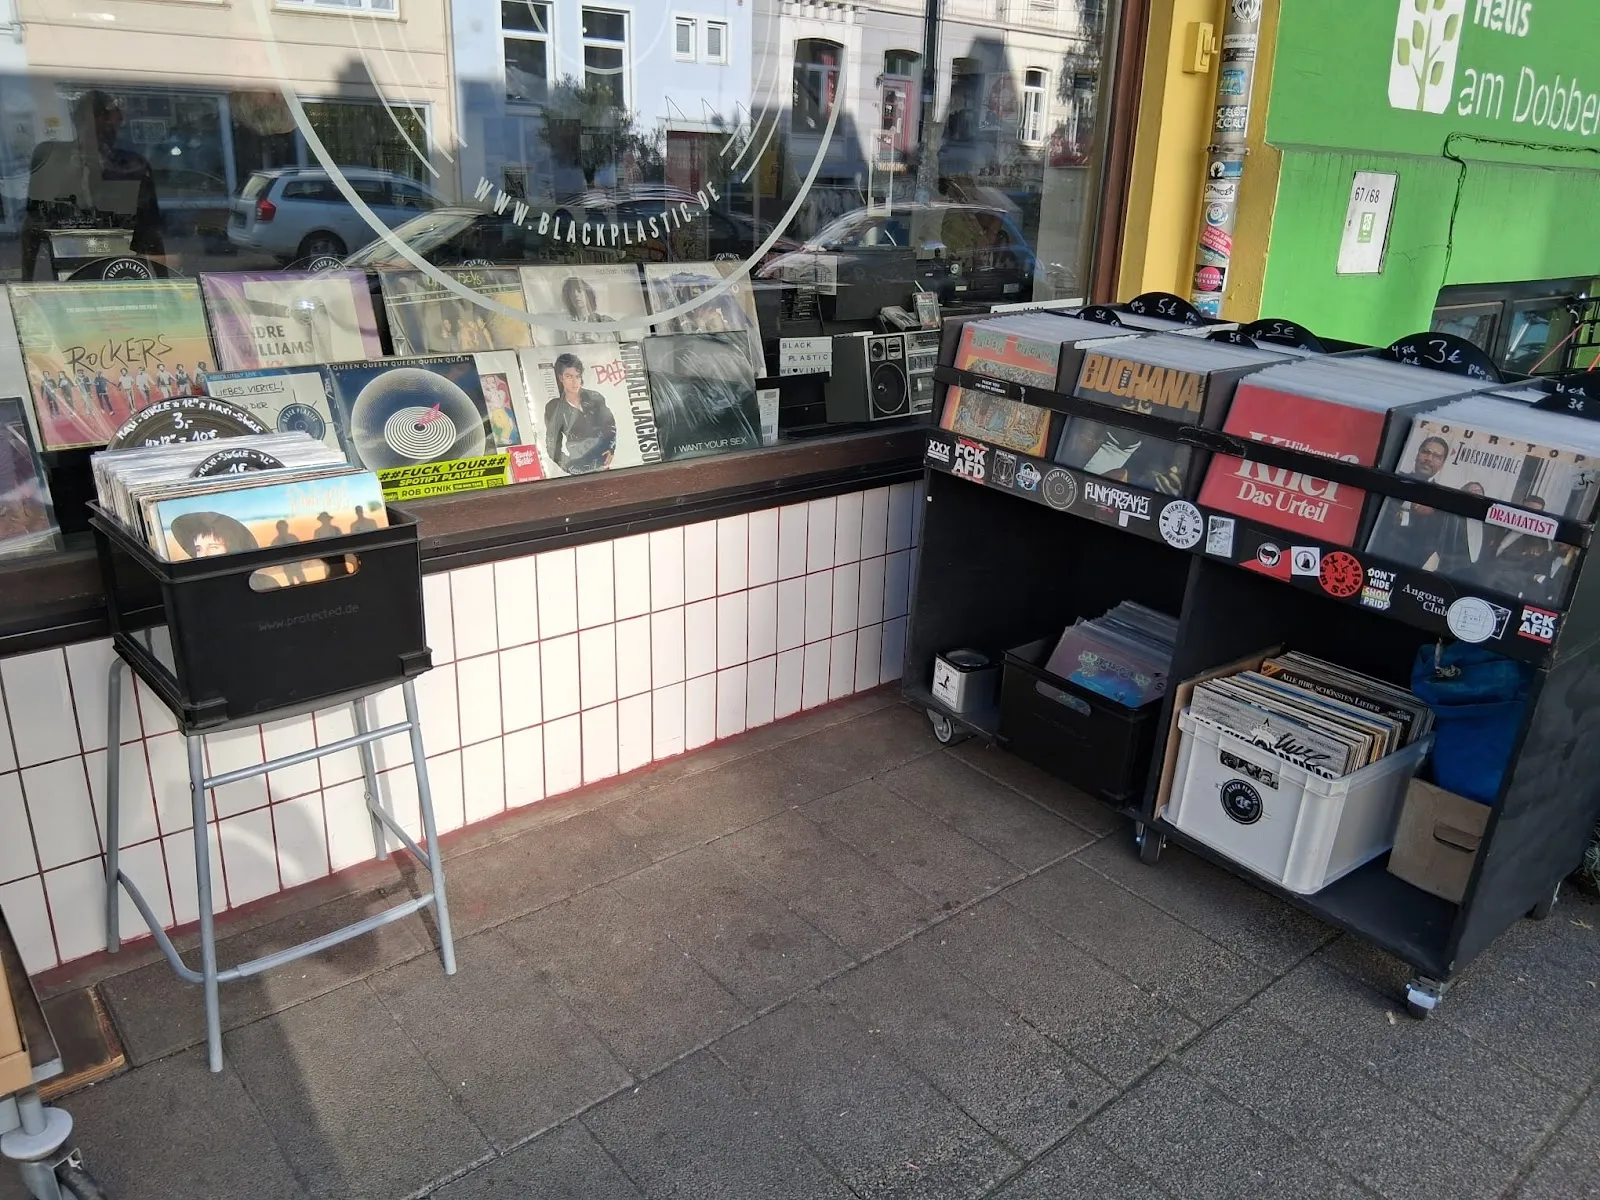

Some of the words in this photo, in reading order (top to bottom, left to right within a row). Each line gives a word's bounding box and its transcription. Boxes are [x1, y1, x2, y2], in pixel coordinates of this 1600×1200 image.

[1458, 68, 1504, 119] am
[1354, 187, 1380, 203] 67/68
[474, 177, 720, 246] WWW.BLACKPLASTIC.DE
[108, 263, 125, 278] BLACK
[126, 261, 148, 278] PLASTIC
[1156, 298, 1177, 316] 5€
[1229, 331, 1241, 343] 5€
[1271, 323, 1294, 337] 5€
[62, 334, 173, 374] ROCKERS
[788, 354, 829, 362] PLASTIC
[1391, 345, 1399, 357] 4
[332, 363, 360, 371] QUEEN
[362, 361, 389, 369] QUEEN
[390, 359, 416, 367] QUEEN
[418, 358, 443, 366] QUEEN
[445, 356, 470, 364] QUEEN
[1467, 364, 1486, 375] PRO
[215, 386, 245, 396] LIEBES
[249, 381, 285, 393] VIERTEL!
[1079, 353, 1201, 413] BUCHANA
[250, 402, 269, 410] DER
[1568, 397, 1585, 411] 3€
[282, 409, 297, 423] BLACK
[296, 407, 318, 422] PLASTIC
[631, 406, 661, 463] JACKSO
[1420, 420, 1500, 445] FOUR
[678, 443, 703, 453] WANT
[703, 438, 728, 450] YOUR
[729, 436, 748, 446] SEX
[928, 440, 951, 456] XXX
[954, 442, 986, 466] FCK
[1452, 441, 1522, 475] INDESTRUCTIBLE
[229, 462, 248, 474] 1€
[379, 463, 443, 481] ##FUCK
[448, 456, 507, 472] YOUR##
[952, 457, 985, 479] AFD
[399, 474, 443, 487] SPOTIFY
[443, 468, 485, 481] PLAYLIST
[401, 488, 421, 498] ROB
[424, 485, 452, 494] OTNIK
[1236, 480, 1273, 507] Das
[1275, 490, 1329, 523] Urteil
[1166, 503, 1188, 515] VIERTEL
[1187, 506, 1201, 524] BIER
[1489, 506, 1555, 536] DRAMATIST
[1367, 567, 1397, 583] DON'T
[1369, 577, 1391, 591] HIDE
[1363, 587, 1392, 600] SHOW
[1402, 583, 1445, 605] Angora
[1363, 597, 1391, 610] PRIDE
[1422, 601, 1448, 617] Club
[258, 604, 360, 632] www.protected.de
[1521, 609, 1557, 629] FCK
[1518, 621, 1554, 639] AFD
[1280, 672, 1298, 684] ALLE
[1298, 679, 1315, 690] IHRE
[1315, 685, 1355, 704] SCHÖNSTEN
[1354, 696, 1381, 712] LIEDER
[1226, 783, 1242, 793] BLACK
[1241, 785, 1258, 805] PLASTIC
